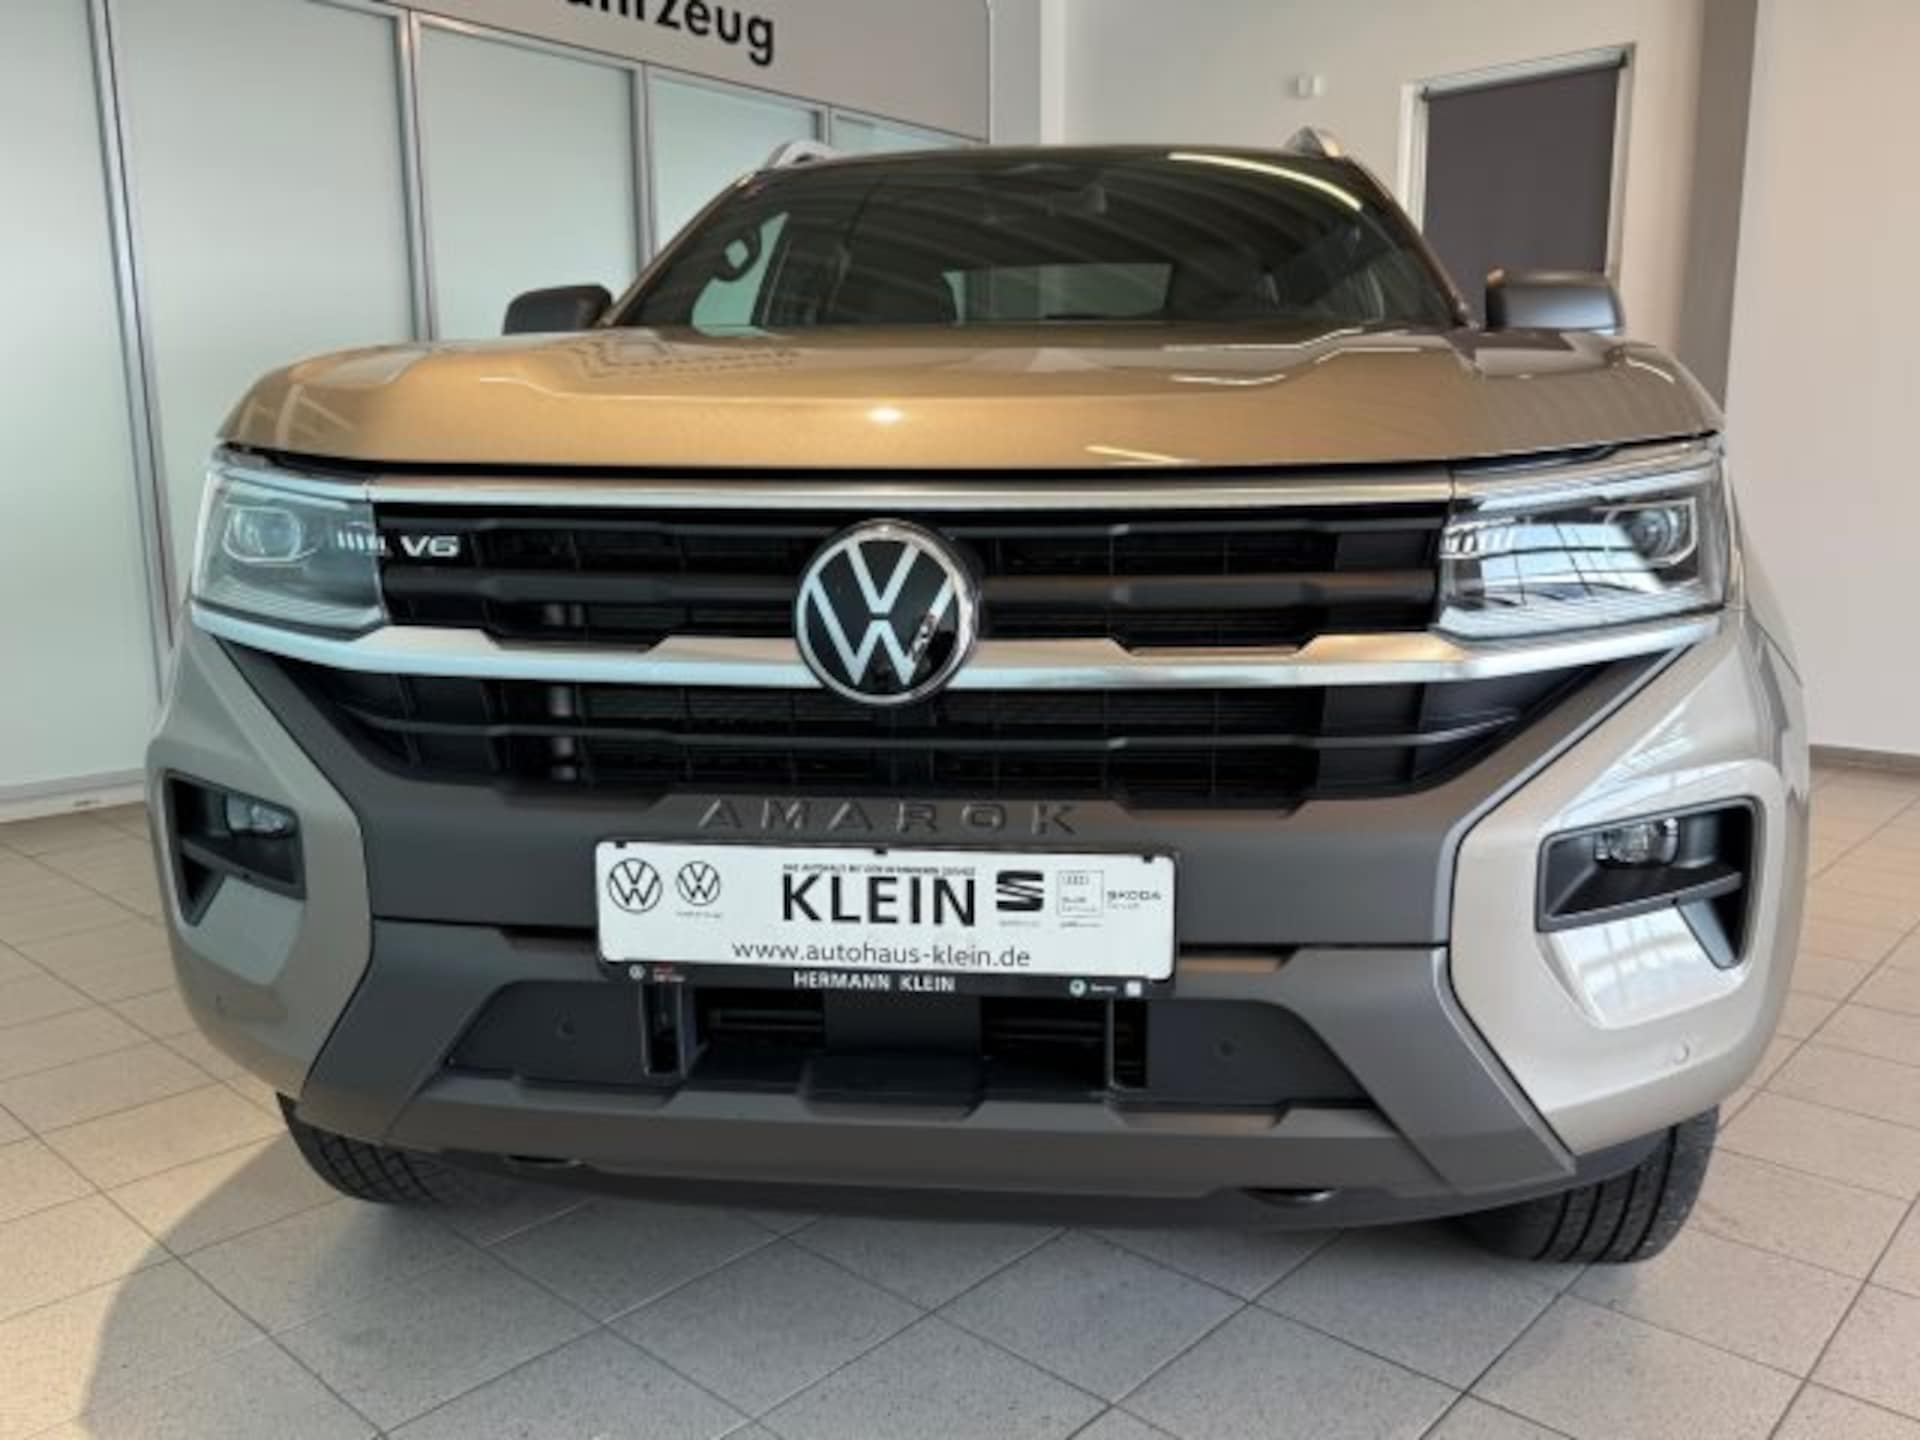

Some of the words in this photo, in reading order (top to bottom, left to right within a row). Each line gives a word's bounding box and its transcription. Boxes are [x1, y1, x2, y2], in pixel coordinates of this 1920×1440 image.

[401, 535, 460, 558] V6
[698, 798, 1076, 835] AMAROK
[783, 873, 975, 927] KLEIN
[731, 940, 1031, 968] www.autohaus-klein.de
[793, 971, 891, 991] HERMANN
[900, 976, 956, 993] KLEIN
